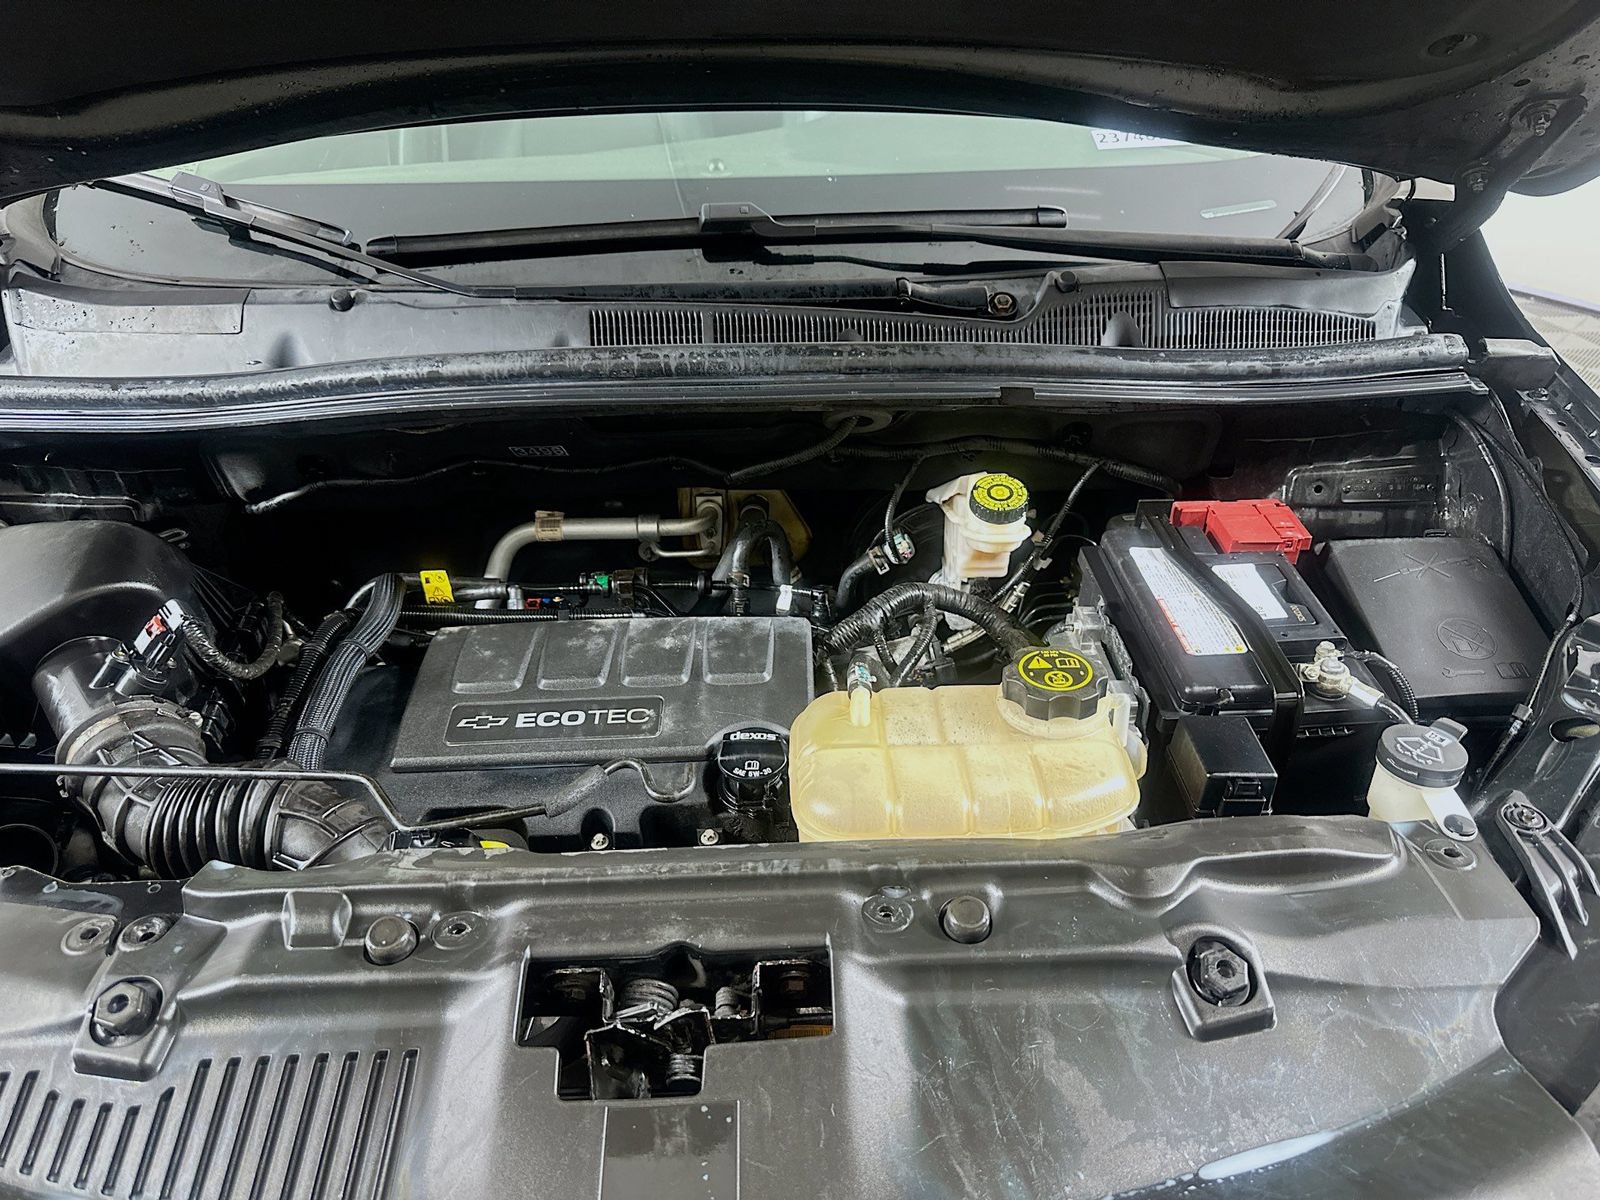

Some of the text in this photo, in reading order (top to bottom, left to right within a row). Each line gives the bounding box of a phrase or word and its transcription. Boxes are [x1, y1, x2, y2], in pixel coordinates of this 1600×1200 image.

[515, 708, 650, 728] ECOTEC
[730, 731, 776, 741] dexos
[733, 767, 772, 777] SAE 5W-30
